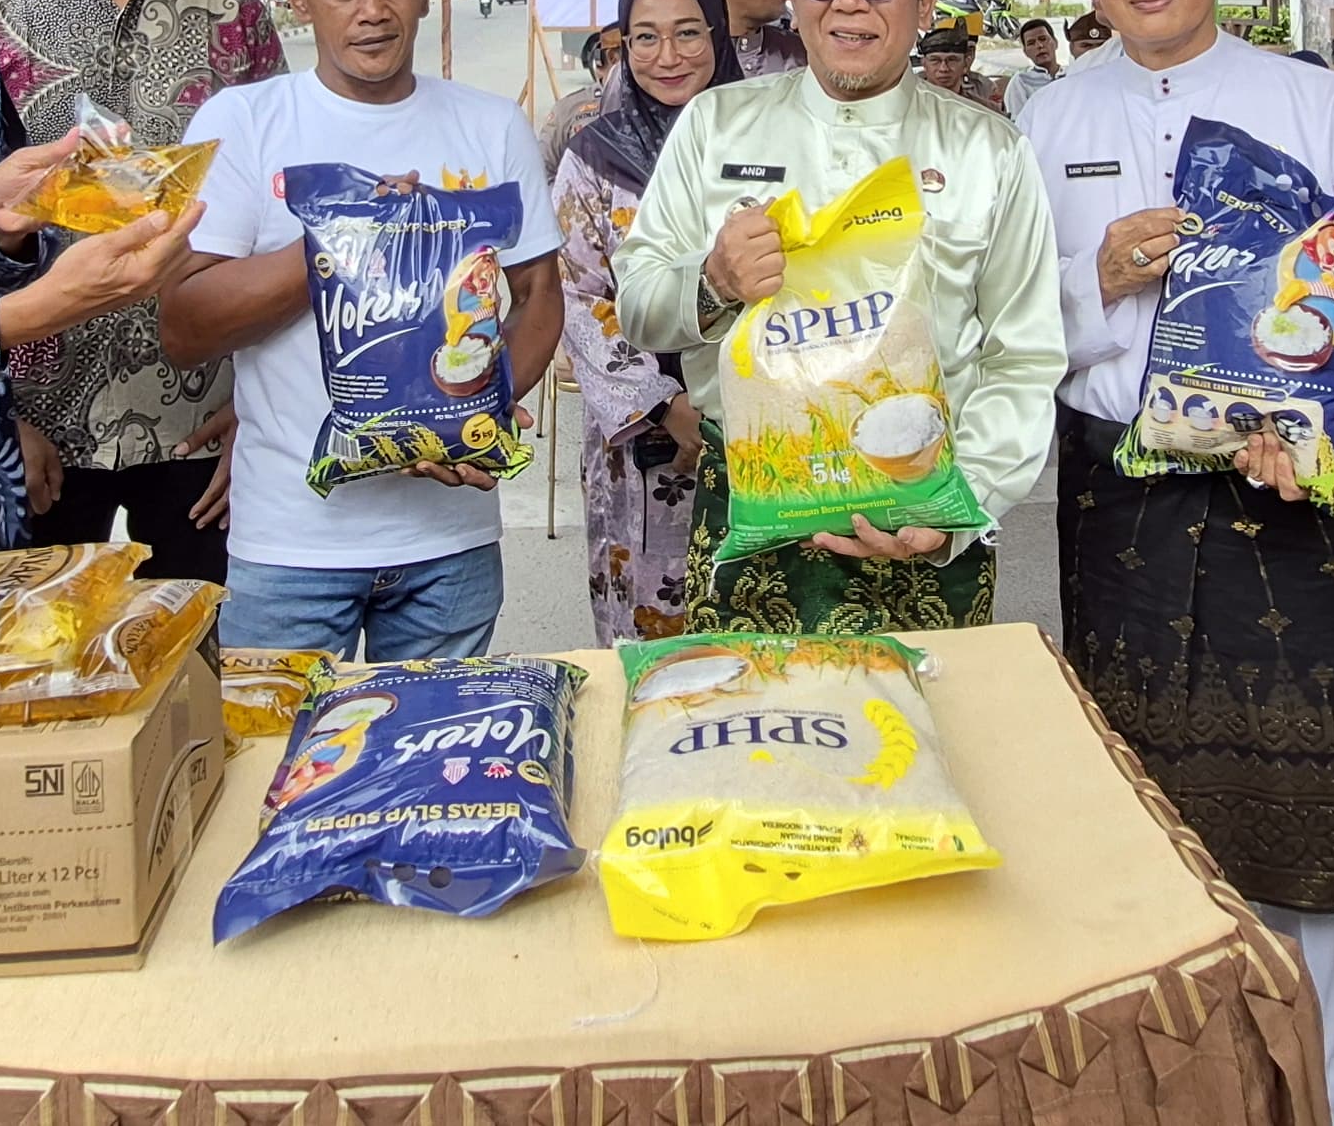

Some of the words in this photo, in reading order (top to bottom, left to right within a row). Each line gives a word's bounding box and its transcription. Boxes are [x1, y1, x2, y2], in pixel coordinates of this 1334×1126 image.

[740, 166, 766, 177] ANDI
[854, 207, 903, 225] bulog
[765, 290, 895, 347] SPHP
[471, 429, 481, 442] 5
[812, 462, 828, 485] 5
[830, 466, 851, 484] kg
[394, 707, 552, 765] Yokers
[669, 715, 849, 755] SPHP
[25, 763, 65, 797] SNI
[305, 810, 382, 832] SUPER
[385, 804, 443, 822] SLYP
[448, 802, 521, 820] BERAS
[626, 825, 696, 850] bulog
[37, 872, 47, 883] x
[52, 867, 70, 882] 12
[75, 865, 100, 881] Pcs
